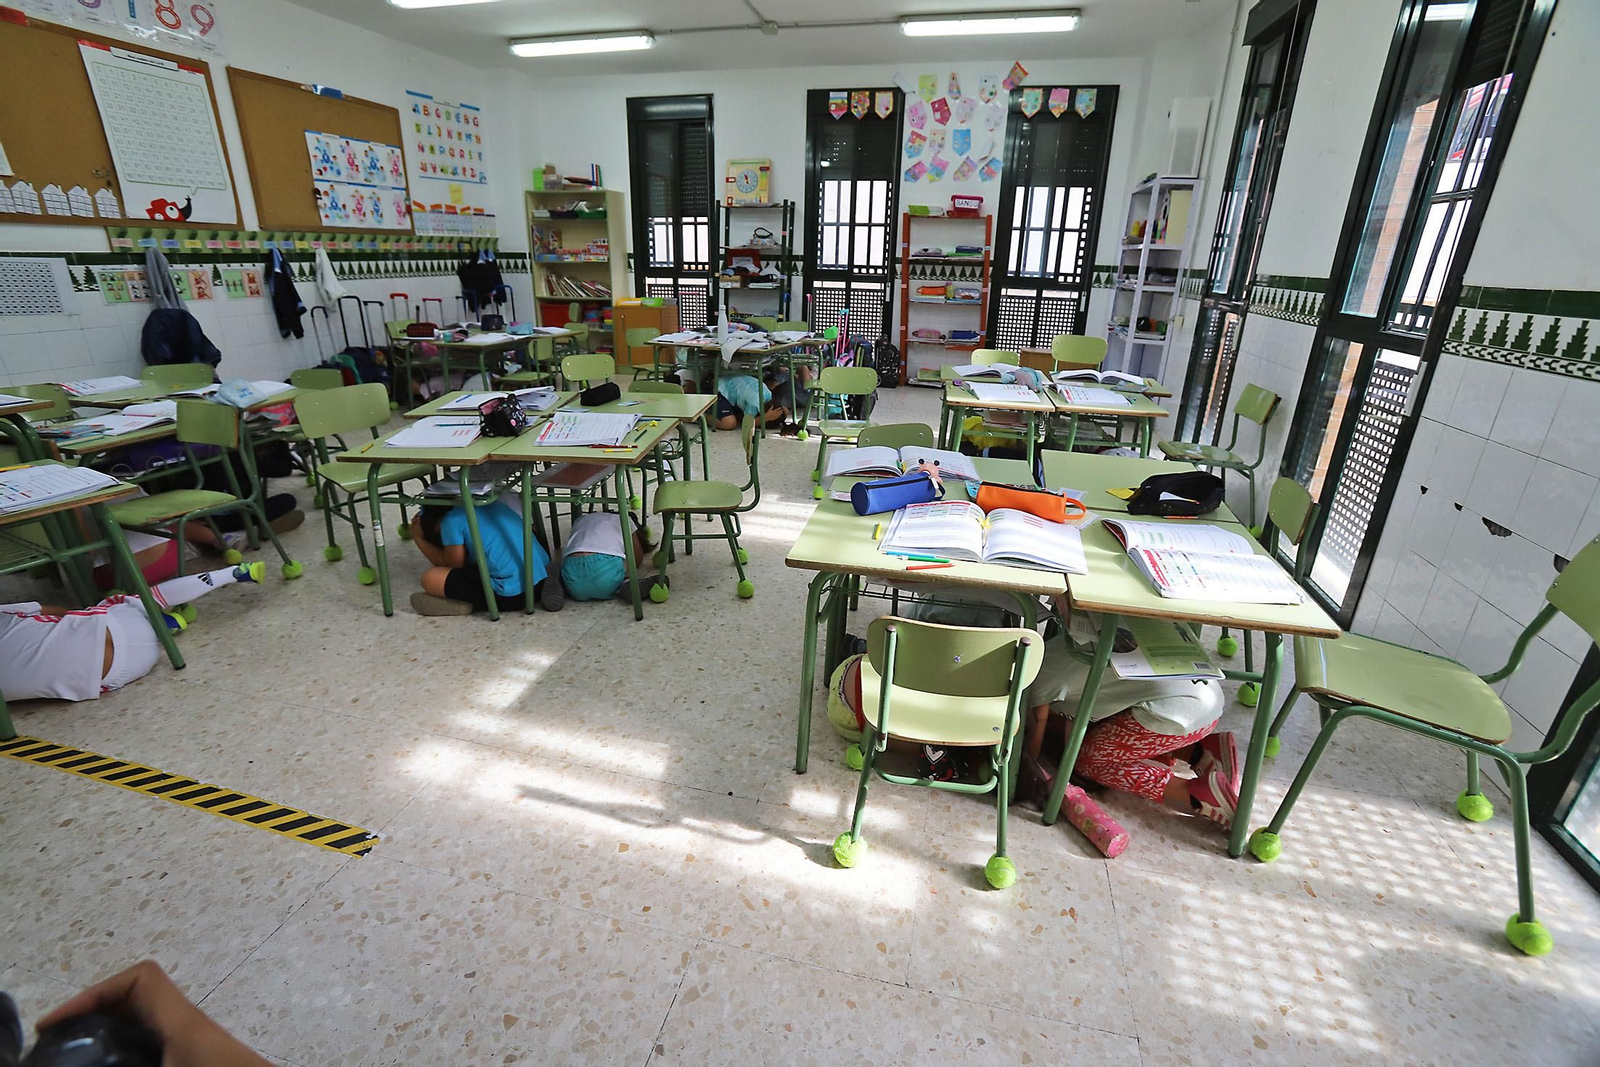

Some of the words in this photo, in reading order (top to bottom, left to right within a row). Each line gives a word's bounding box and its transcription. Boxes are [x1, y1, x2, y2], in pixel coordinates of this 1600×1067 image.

[155, 0, 182, 30] 8
[190, 4, 215, 36] 9
[414, 103, 420, 115] A
[423, 105, 430, 116] B
[472, 116, 479, 127] G
